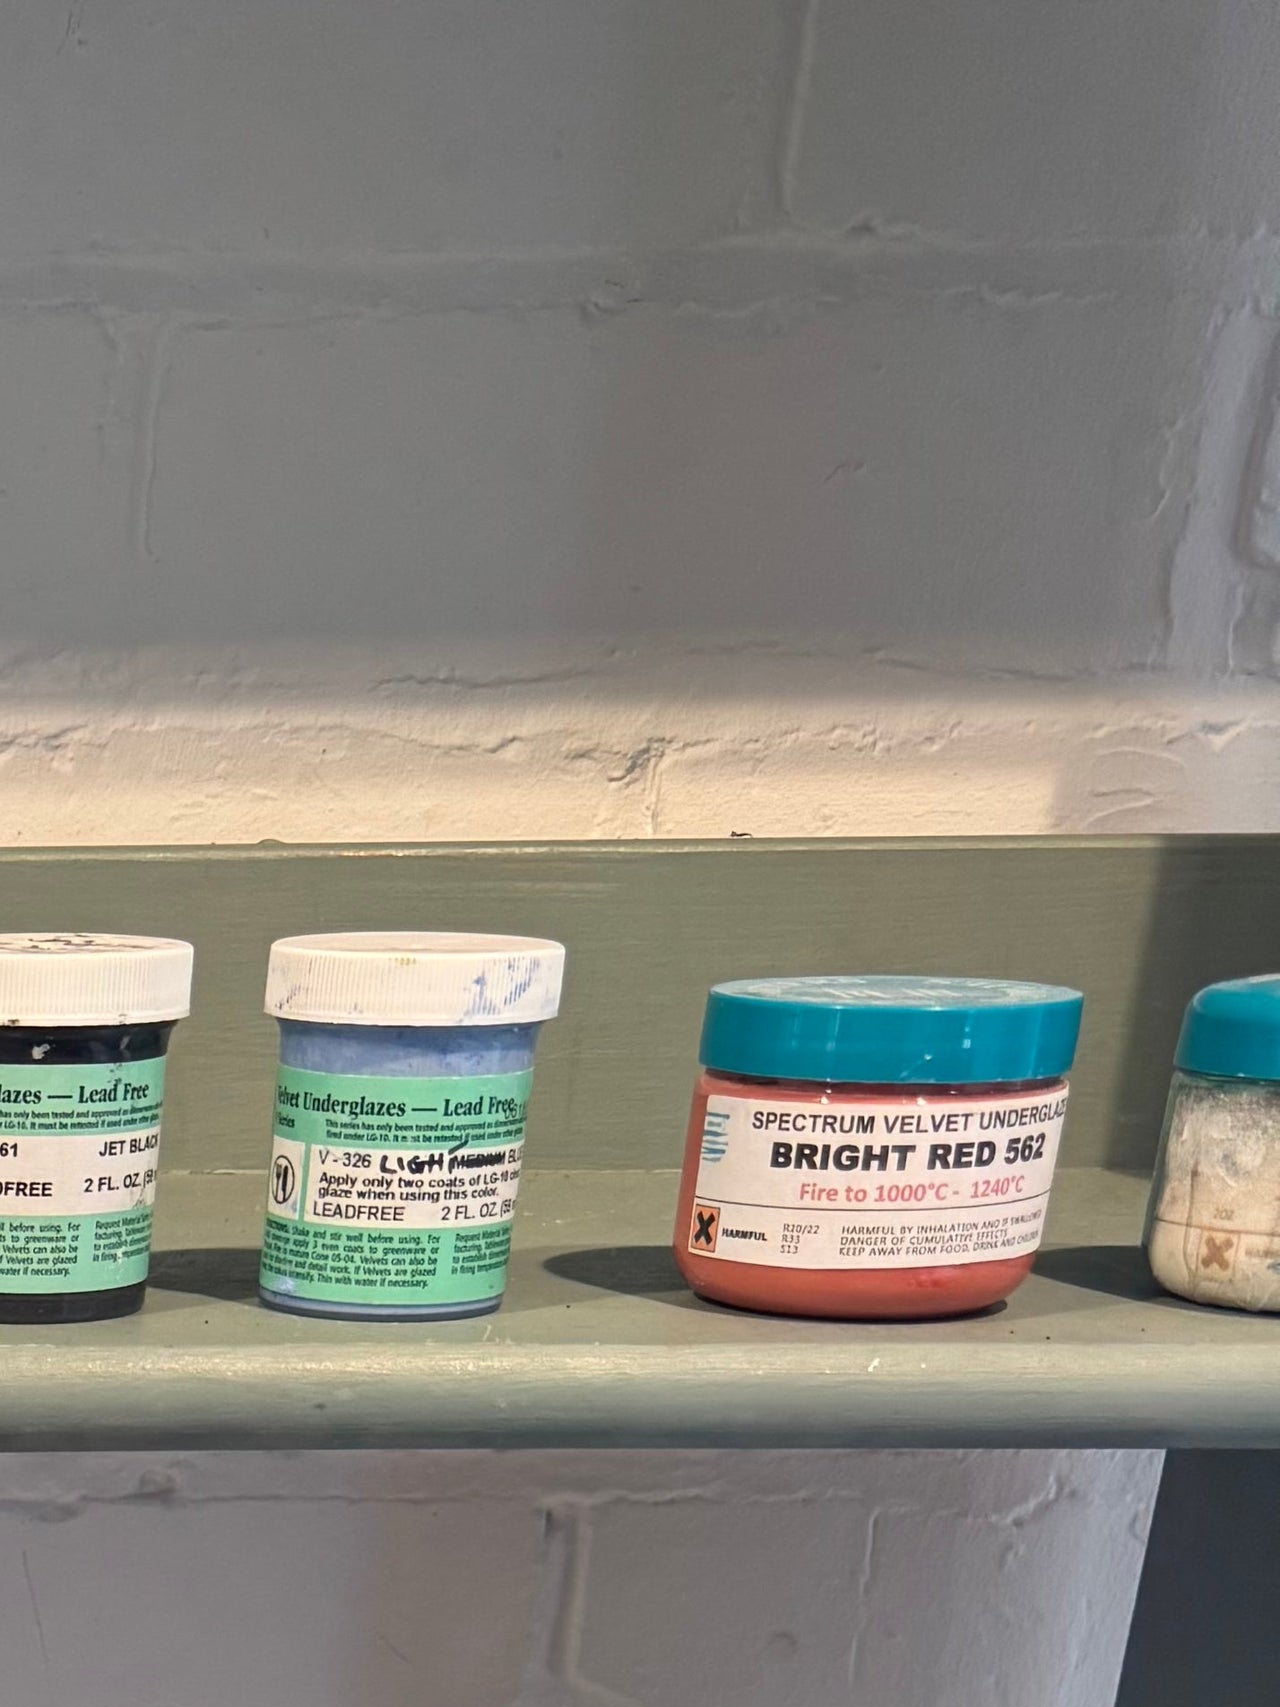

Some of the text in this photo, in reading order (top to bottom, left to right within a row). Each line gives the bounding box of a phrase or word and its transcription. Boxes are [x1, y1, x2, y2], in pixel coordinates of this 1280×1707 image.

[78, 1082, 118, 1104] Lead
[122, 1083, 150, 1101] Free
[303, 1091, 406, 1120] Underglazes
[443, 1095, 483, 1117] Lead
[488, 1096, 515, 1115] Free
[752, 1097, 1067, 1135] SPECTRUM VELVET UNDERGLAZ
[99, 1140, 126, 1157] JET
[770, 1132, 1046, 1172] BRIGHT RED 562
[318, 1150, 330, 1165] V
[343, 1151, 372, 1169] 326
[84, 1178, 94, 1193] 2
[319, 1172, 357, 1189] Apply
[362, 1177, 393, 1190] only
[397, 1175, 424, 1189] two
[428, 1175, 465, 1189] coats
[469, 1173, 481, 1187] of
[799, 1182, 839, 1202] Fire
[844, 1184, 868, 1202] to
[874, 1183, 949, 1202] 1000°C
[970, 1174, 1025, 1200] 1240°C
[318, 1186, 499, 1204] glaze when using this color.
[313, 1201, 406, 1222] LEADFREE
[441, 1207, 450, 1221] 2
[721, 1227, 768, 1242] HARMFUL
[782, 1223, 820, 1235] R20/22
[841, 1225, 895, 1236] HARMFUL
[900, 1225, 914, 1236] BY
[917, 1221, 979, 1235] INHALATION
[840, 1236, 887, 1246] DANGER
[891, 1236, 905, 1245] OF
[839, 1246, 865, 1257] KEEP
[869, 1247, 901, 1257] AWAY
[905, 1246, 937, 1256] FROM
